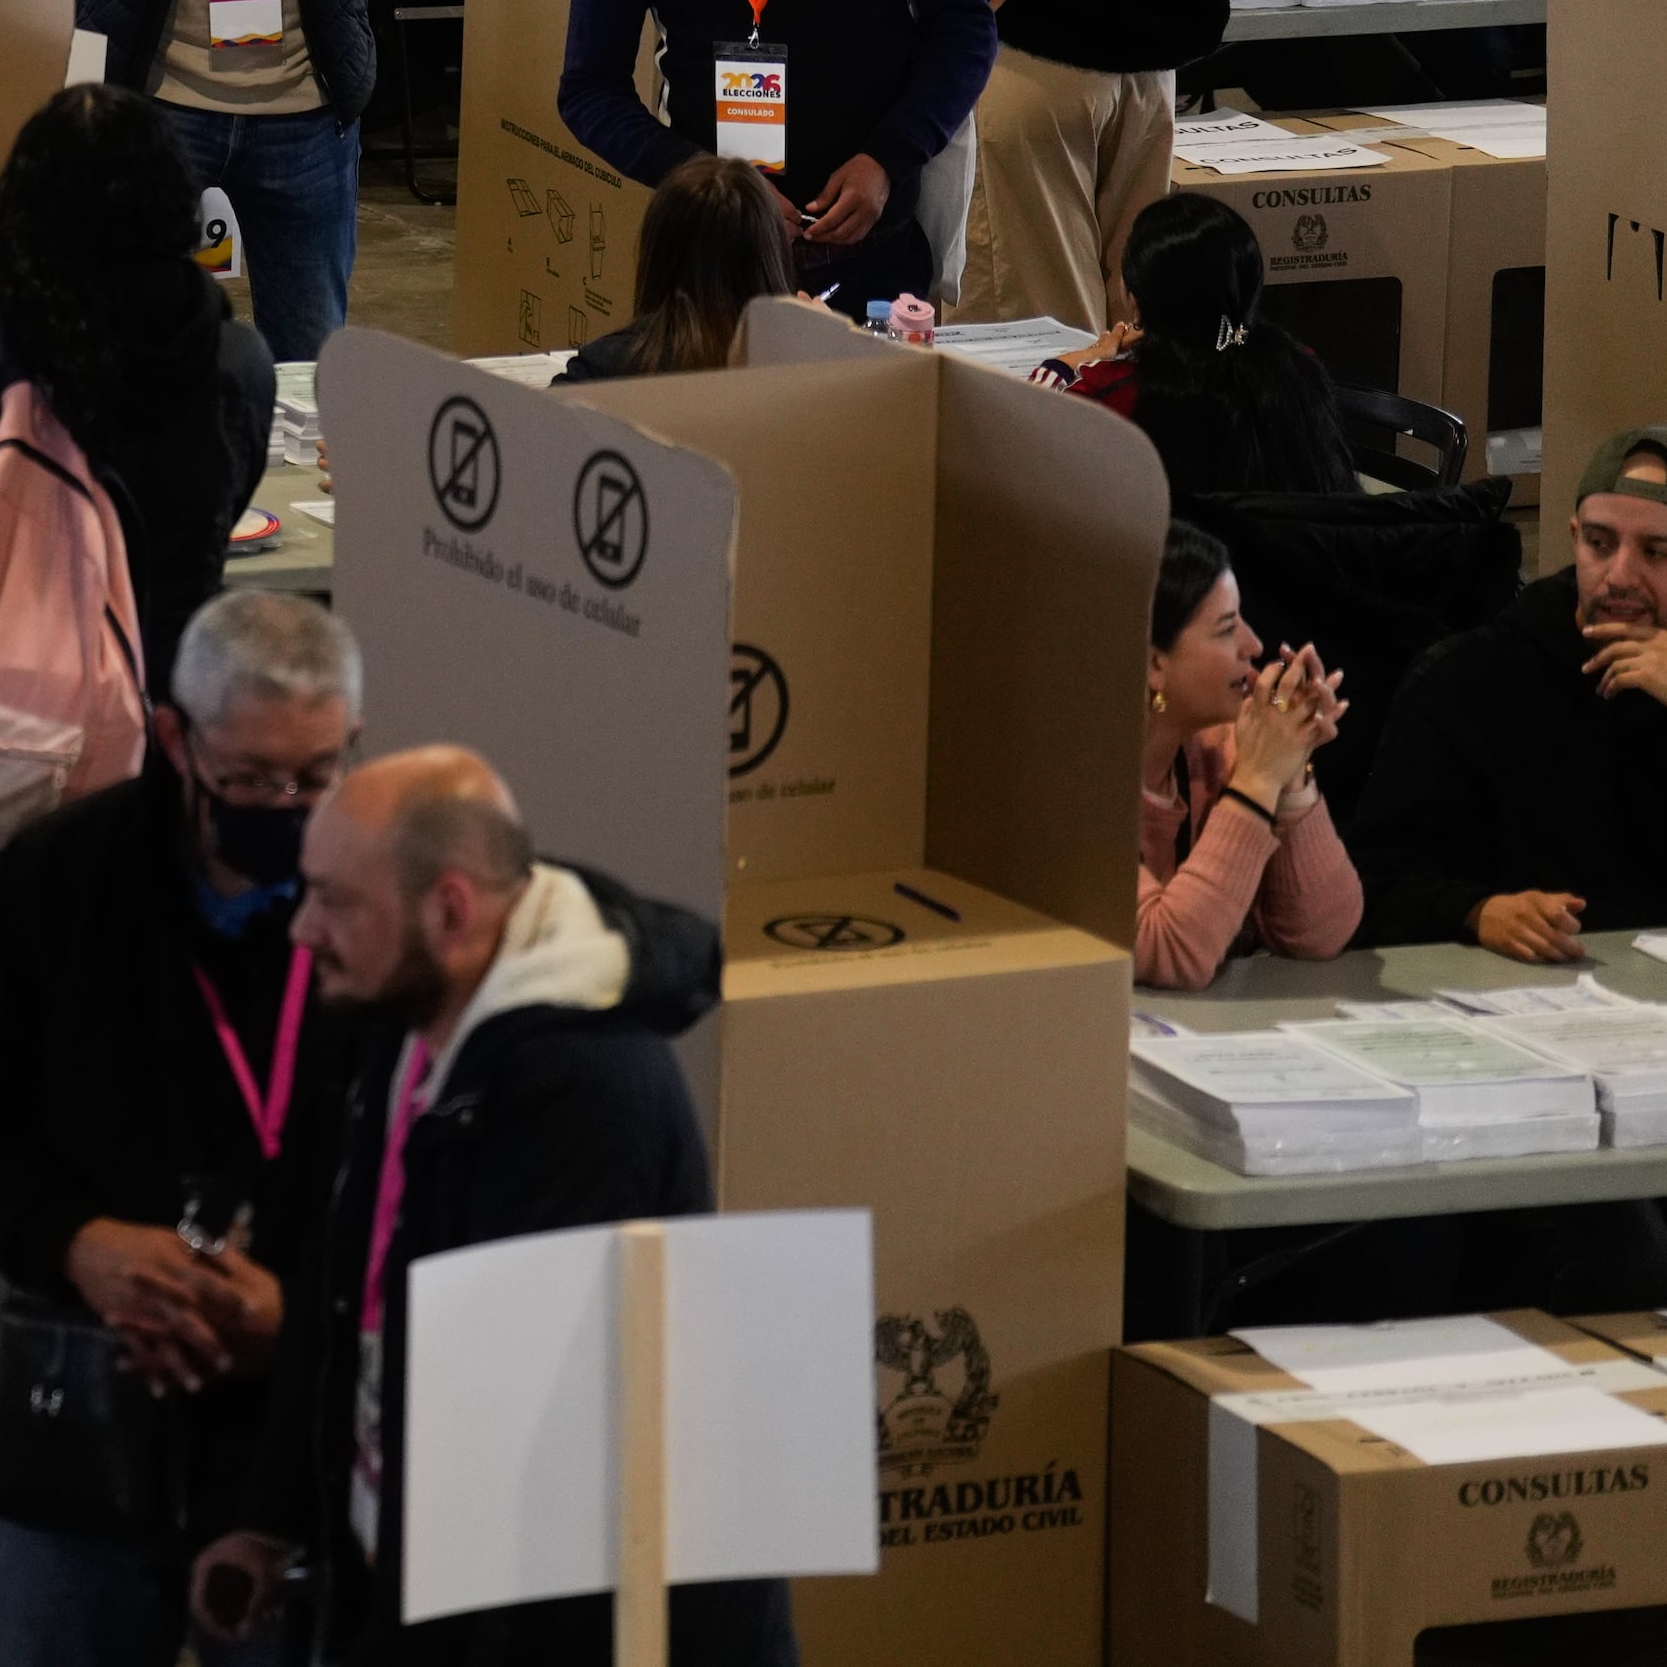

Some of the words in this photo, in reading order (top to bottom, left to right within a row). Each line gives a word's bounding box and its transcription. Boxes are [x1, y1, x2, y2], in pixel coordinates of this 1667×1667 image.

[721, 72, 780, 90] 2026
[723, 89, 781, 98] ELECCIONES
[727, 108, 774, 117] CONSULADO
[1175, 121, 1259, 134] SULTAS
[1200, 148, 1357, 165] CONSULTAS
[1253, 185, 1371, 208] CONSULTAS
[1270, 252, 1347, 265] REGISTRADURÍA
[881, 1461, 1082, 1522] TRADURÍA
[1458, 1463, 1649, 1507] CONSULTAS
[925, 1515, 1015, 1542] ESTADO
[1022, 1508, 1083, 1531] CIVIL
